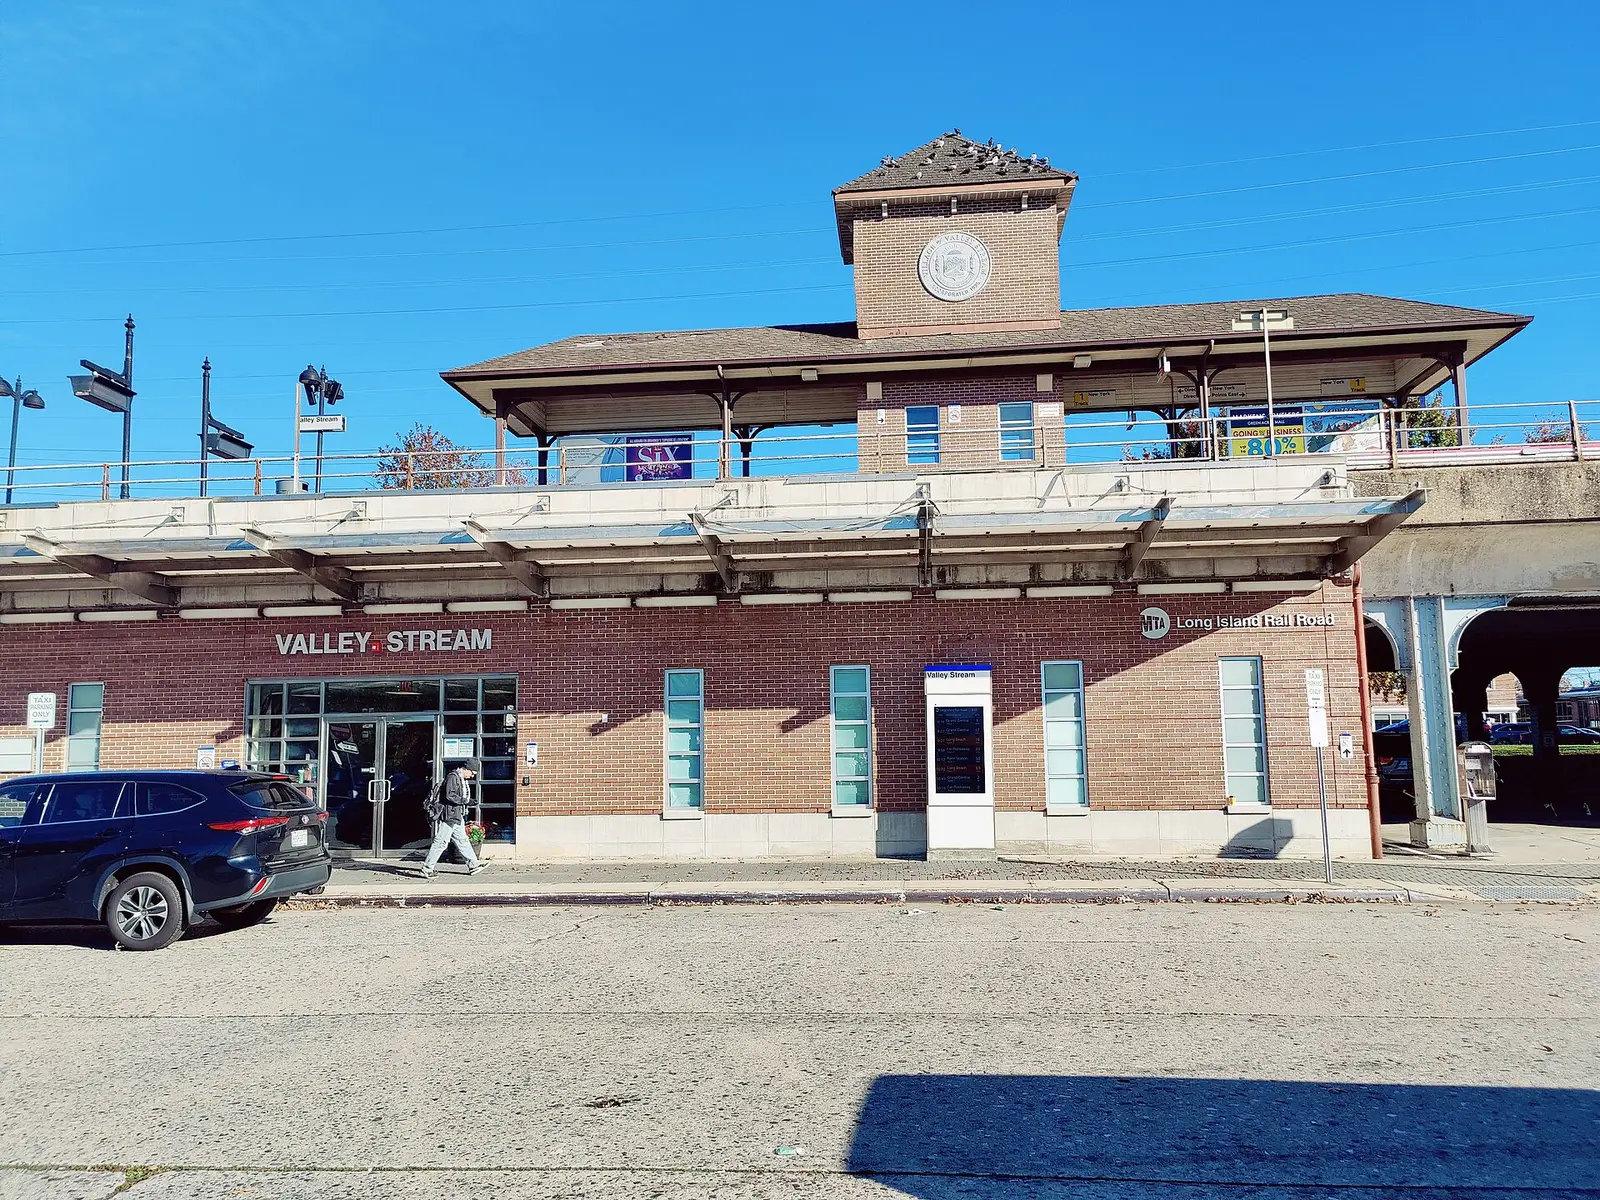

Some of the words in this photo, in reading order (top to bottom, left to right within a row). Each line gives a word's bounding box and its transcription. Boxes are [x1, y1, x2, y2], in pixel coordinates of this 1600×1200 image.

[638, 445, 681, 468] SIX
[1141, 614, 1166, 633] MTA
[1177, 616, 1212, 630] Long
[1216, 614, 1260, 628] Island
[1264, 614, 1292, 627] Rail
[1296, 613, 1335, 627] Road
[275, 631, 372, 655] VALLEY
[386, 628, 493, 653] STREAM
